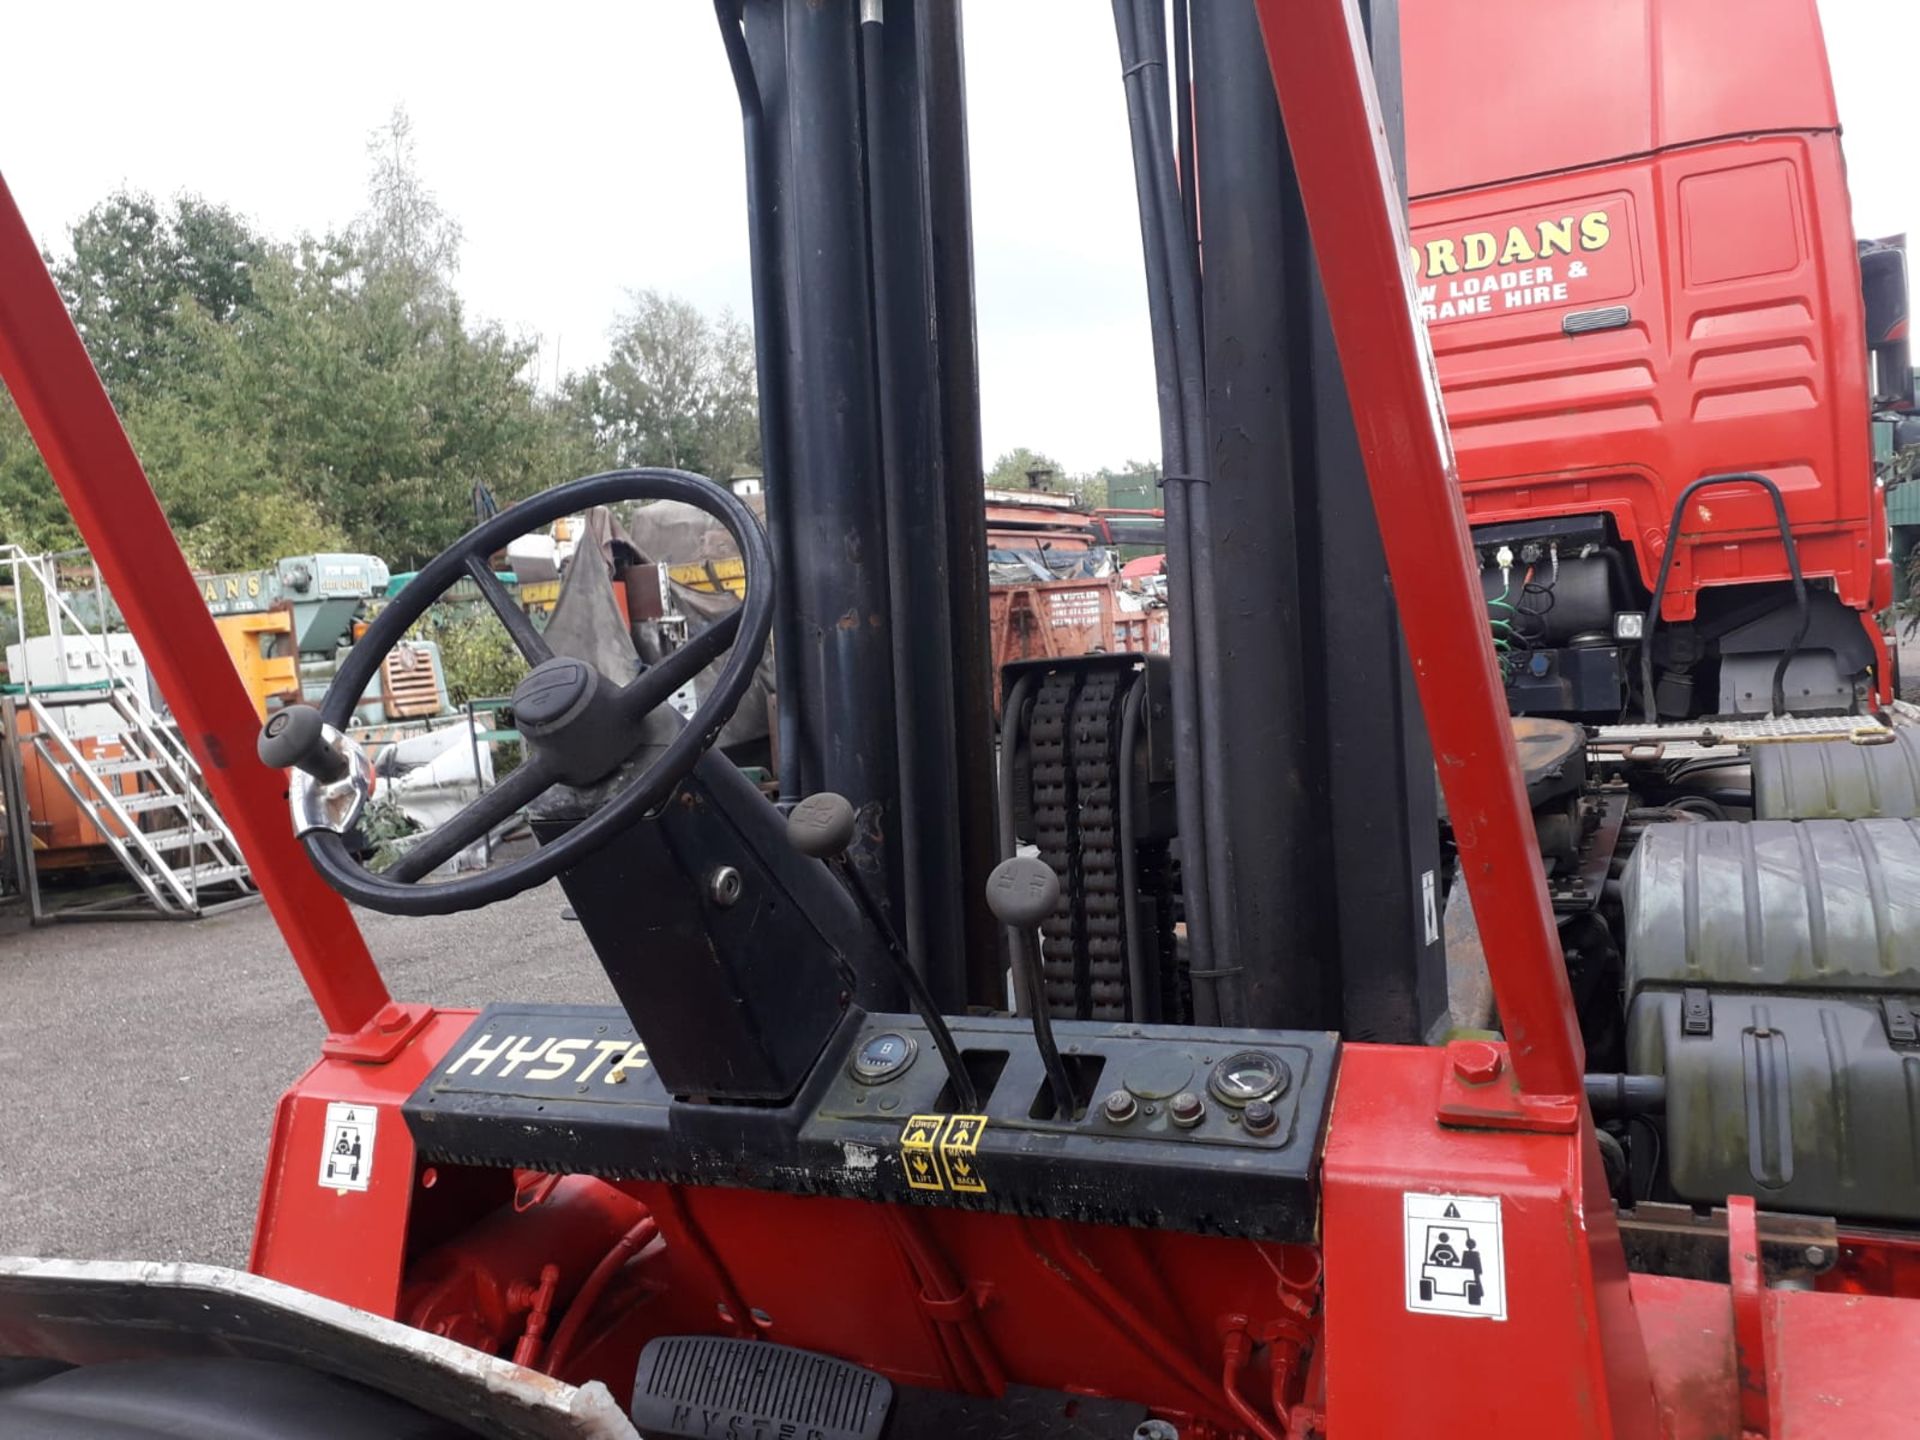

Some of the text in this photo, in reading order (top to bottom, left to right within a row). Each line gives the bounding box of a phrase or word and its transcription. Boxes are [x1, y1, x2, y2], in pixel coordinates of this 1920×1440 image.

[1450, 266, 1553, 298] LOADER
[1568, 261, 1588, 278] &
[1505, 284, 1568, 308] HIRE
[911, 1120, 937, 1128] LOWER
[959, 1121, 975, 1129] TILT
[916, 1175, 932, 1183] LIFT
